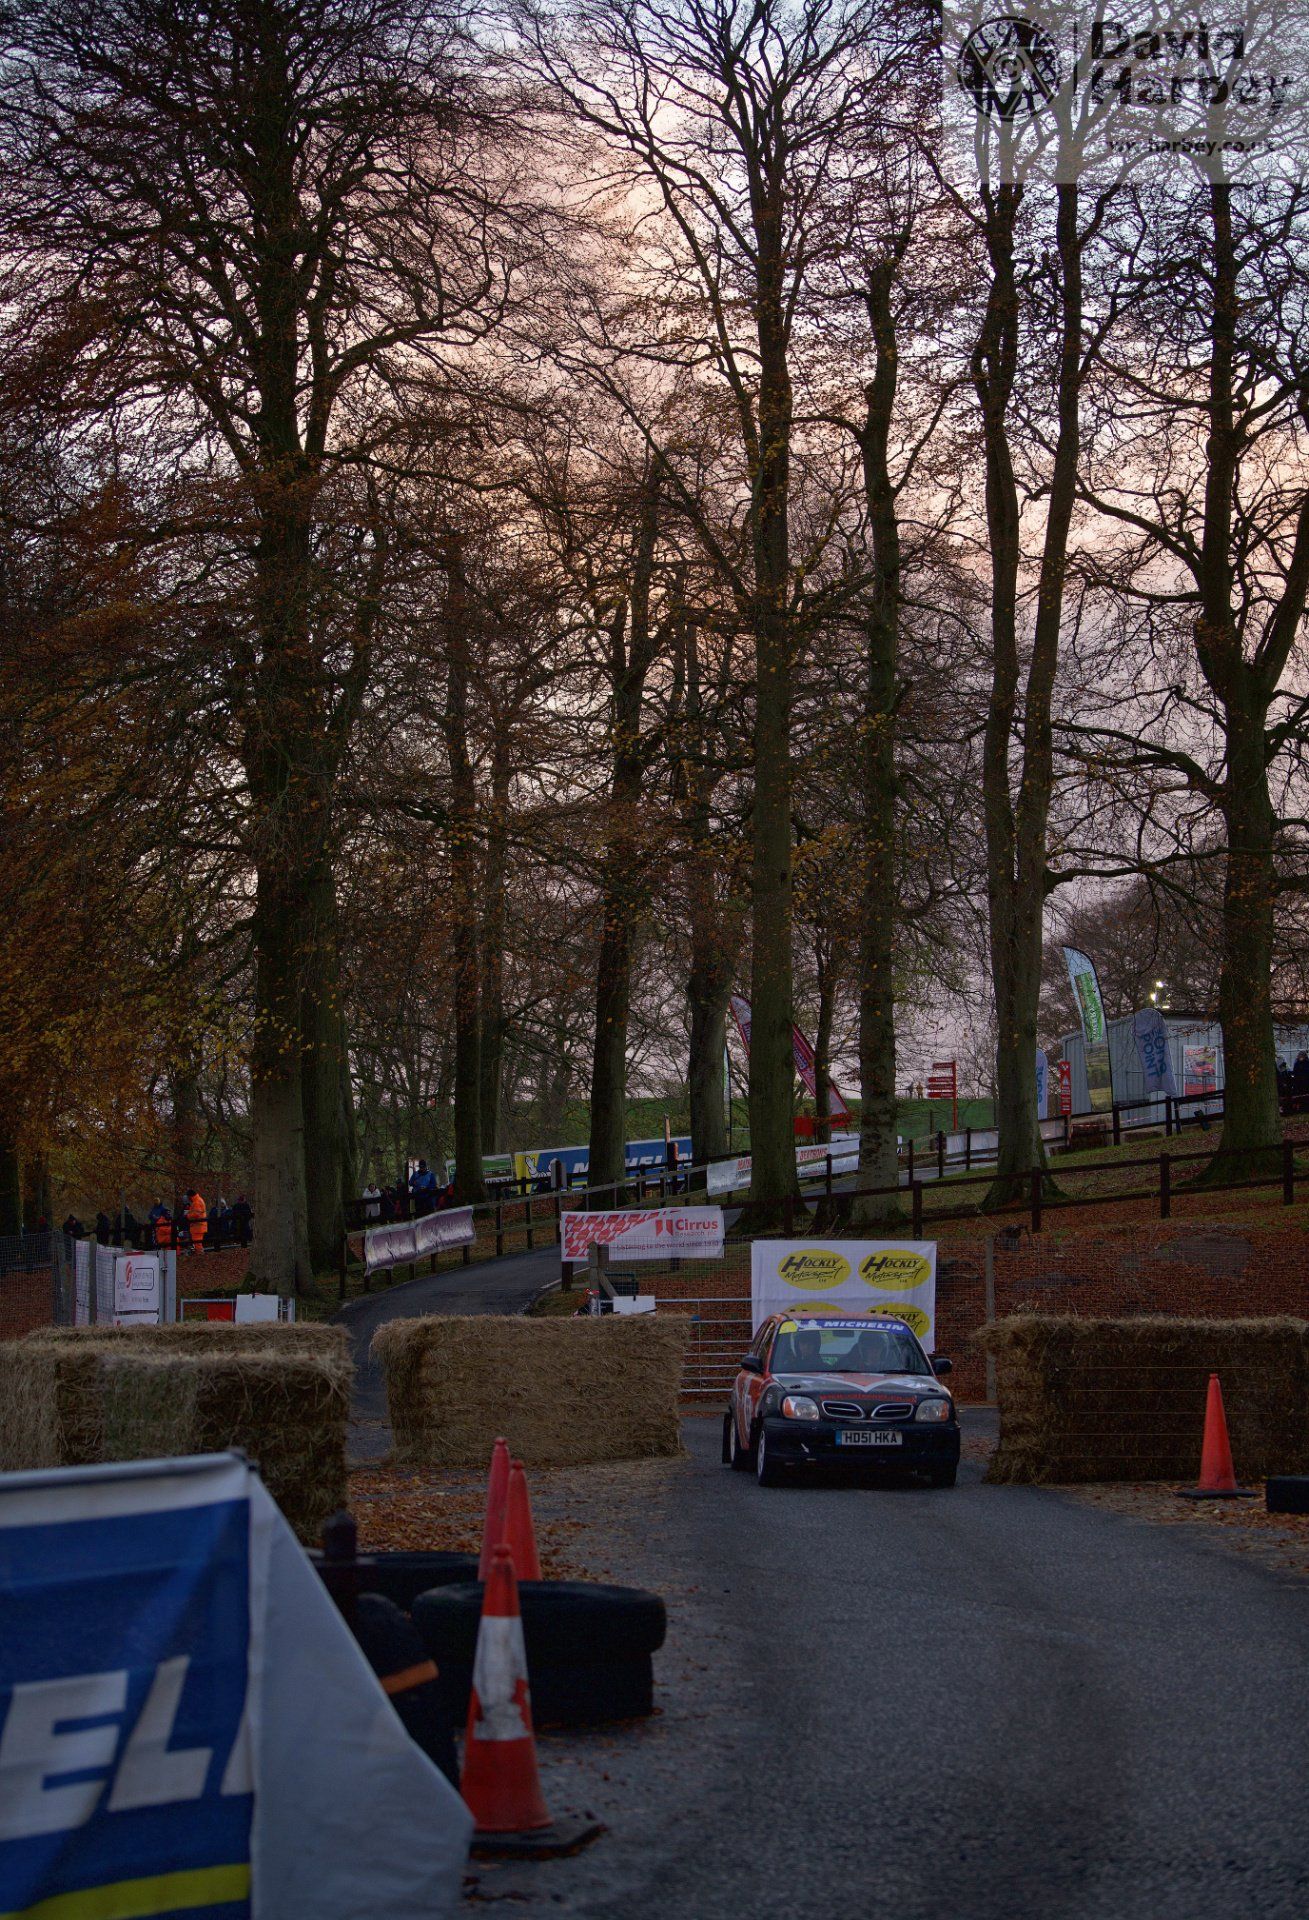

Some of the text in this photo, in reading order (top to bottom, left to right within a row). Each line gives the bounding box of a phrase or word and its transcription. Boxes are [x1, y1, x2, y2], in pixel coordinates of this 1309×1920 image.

[675, 1217, 719, 1231] Cirrus
[823, 1321, 905, 1332] MICHELIN
[874, 1431, 898, 1444] HKA
